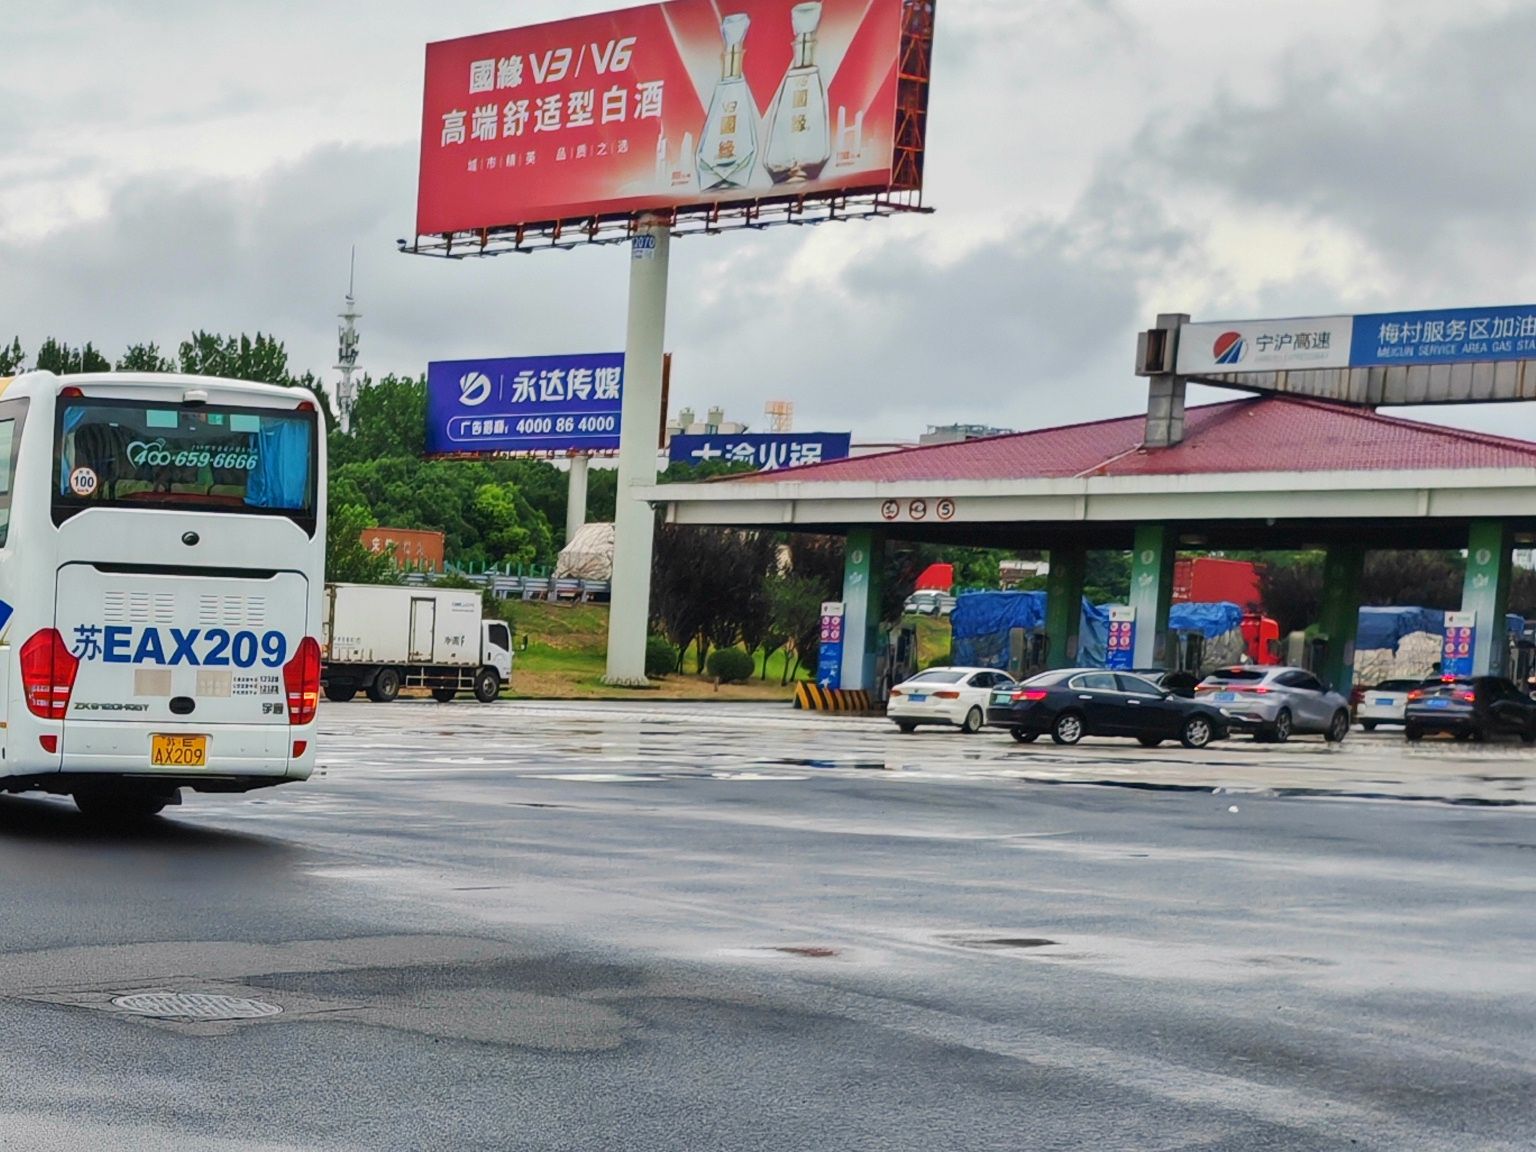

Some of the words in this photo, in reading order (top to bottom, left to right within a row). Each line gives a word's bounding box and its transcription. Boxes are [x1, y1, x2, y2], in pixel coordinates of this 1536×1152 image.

[441, 80, 664, 147] 高端舒适型白酒
[1256, 332, 1331, 352] 宁沪高速
[1462, 342, 1488, 354] AREA
[1492, 340, 1512, 352] GAS
[511, 366, 622, 403] 永达传媒
[516, 417, 552, 434] 4000
[555, 417, 575, 433] 86
[578, 415, 615, 432] 4000
[74, 475, 94, 488] 100
[941, 503, 951, 516] 5
[155, 747, 203, 765] AX209
